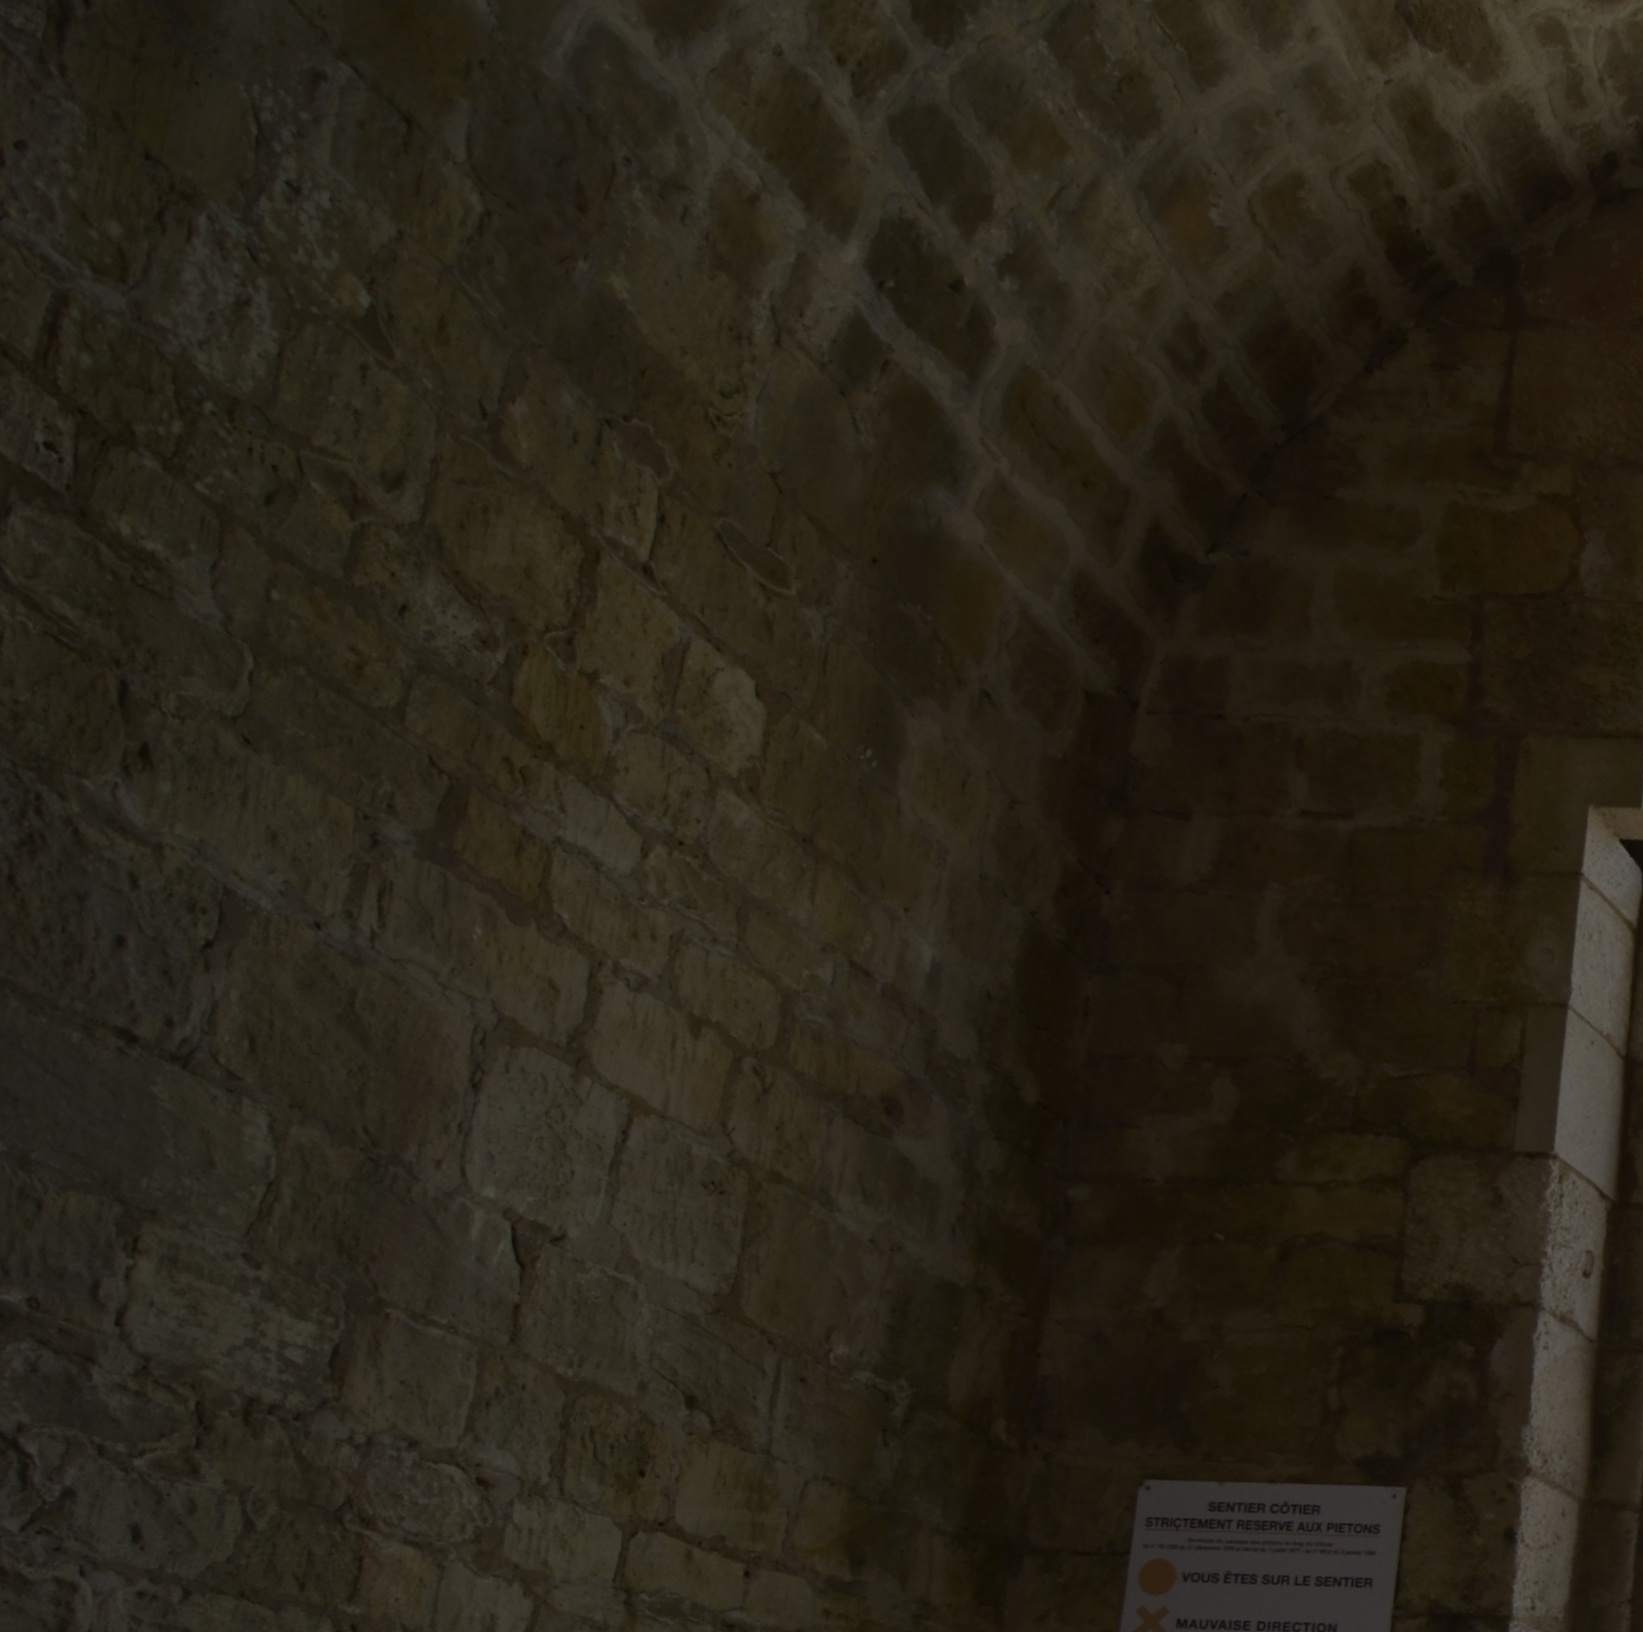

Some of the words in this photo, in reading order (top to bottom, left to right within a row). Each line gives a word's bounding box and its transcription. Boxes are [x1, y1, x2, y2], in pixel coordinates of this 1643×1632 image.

[1207, 1501, 1266, 1514] SENTIER
[1269, 1500, 1321, 1515] CÔTIER
[1144, 1516, 1233, 1530] STRICTEMENT
[1236, 1519, 1294, 1531] RESERVE
[1297, 1521, 1323, 1532] AUX
[1326, 1522, 1381, 1535] PIETONS
[1181, 1572, 1219, 1584] VOUS
[1223, 1570, 1258, 1585] ÊTES
[1261, 1574, 1290, 1585] SUR
[1294, 1575, 1310, 1586] LE
[1314, 1576, 1373, 1589] SENTIER
[1175, 1617, 1251, 1631] MAUVAISE
